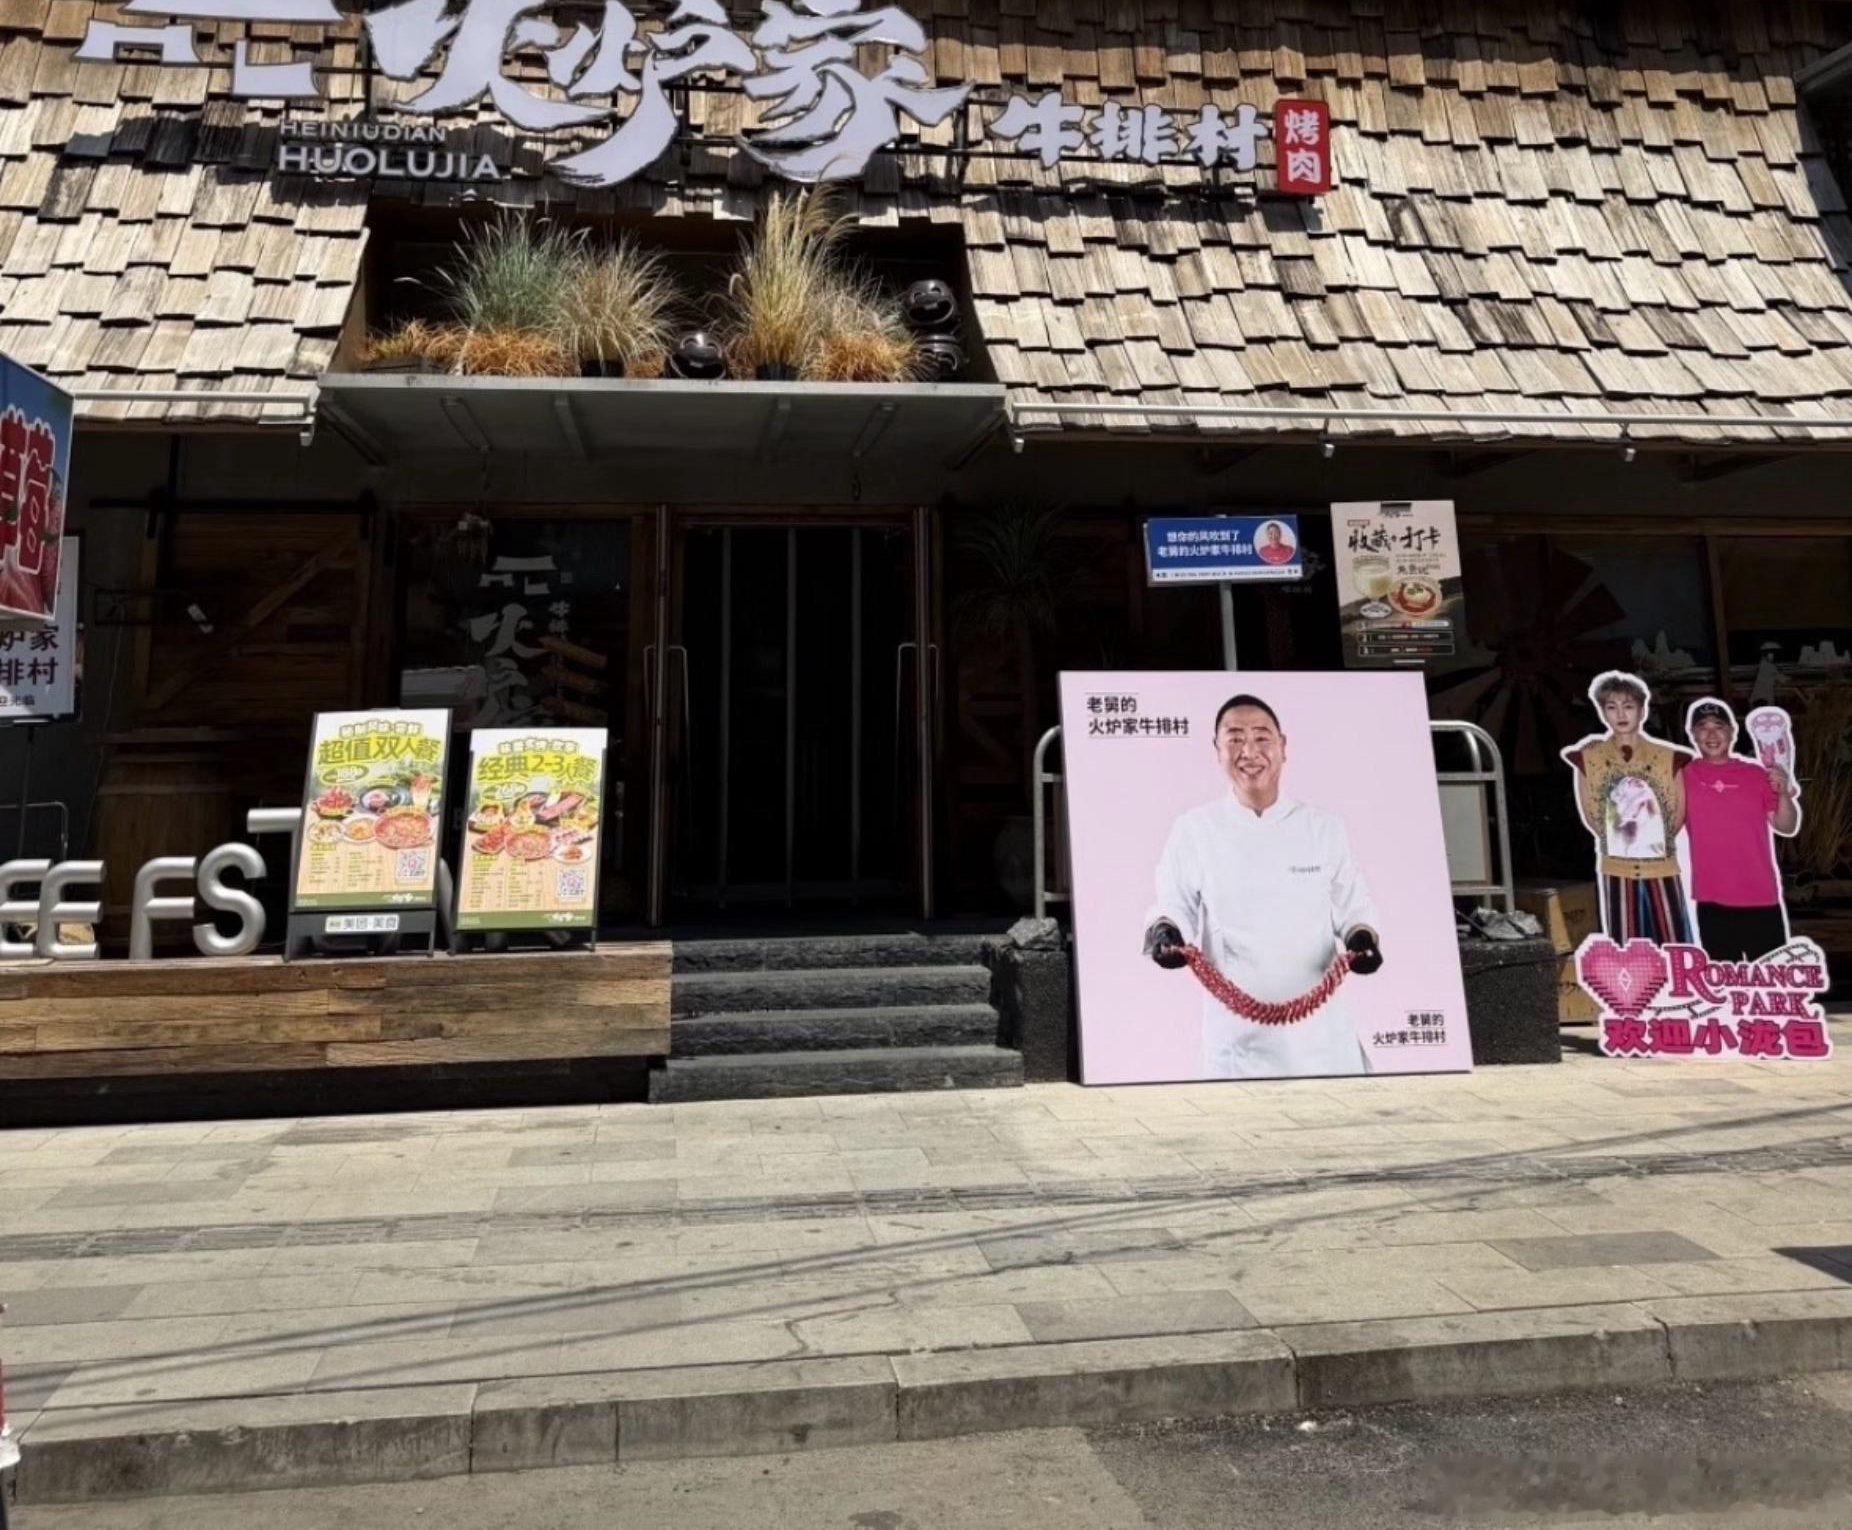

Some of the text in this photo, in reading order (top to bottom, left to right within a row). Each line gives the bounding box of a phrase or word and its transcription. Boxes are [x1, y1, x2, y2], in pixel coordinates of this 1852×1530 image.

[279, 120, 447, 142] HEINIUDIAN
[988, 91, 1270, 172] 牛排村
[1283, 108, 1322, 184] 烤肉
[278, 144, 501, 180] HUOLUJIA
[1086, 695, 1138, 714] 老舅的
[1088, 717, 1190, 736] 火炉家牛排村
[318, 735, 441, 766] 超值双人餐
[1407, 1013, 1445, 1027] 老舅的
[1731, 991, 1820, 1020] PARK
[1372, 1029, 1446, 1045] 火炉家牛排村
[1603, 1018, 1830, 1057] 欢迎小泷包
